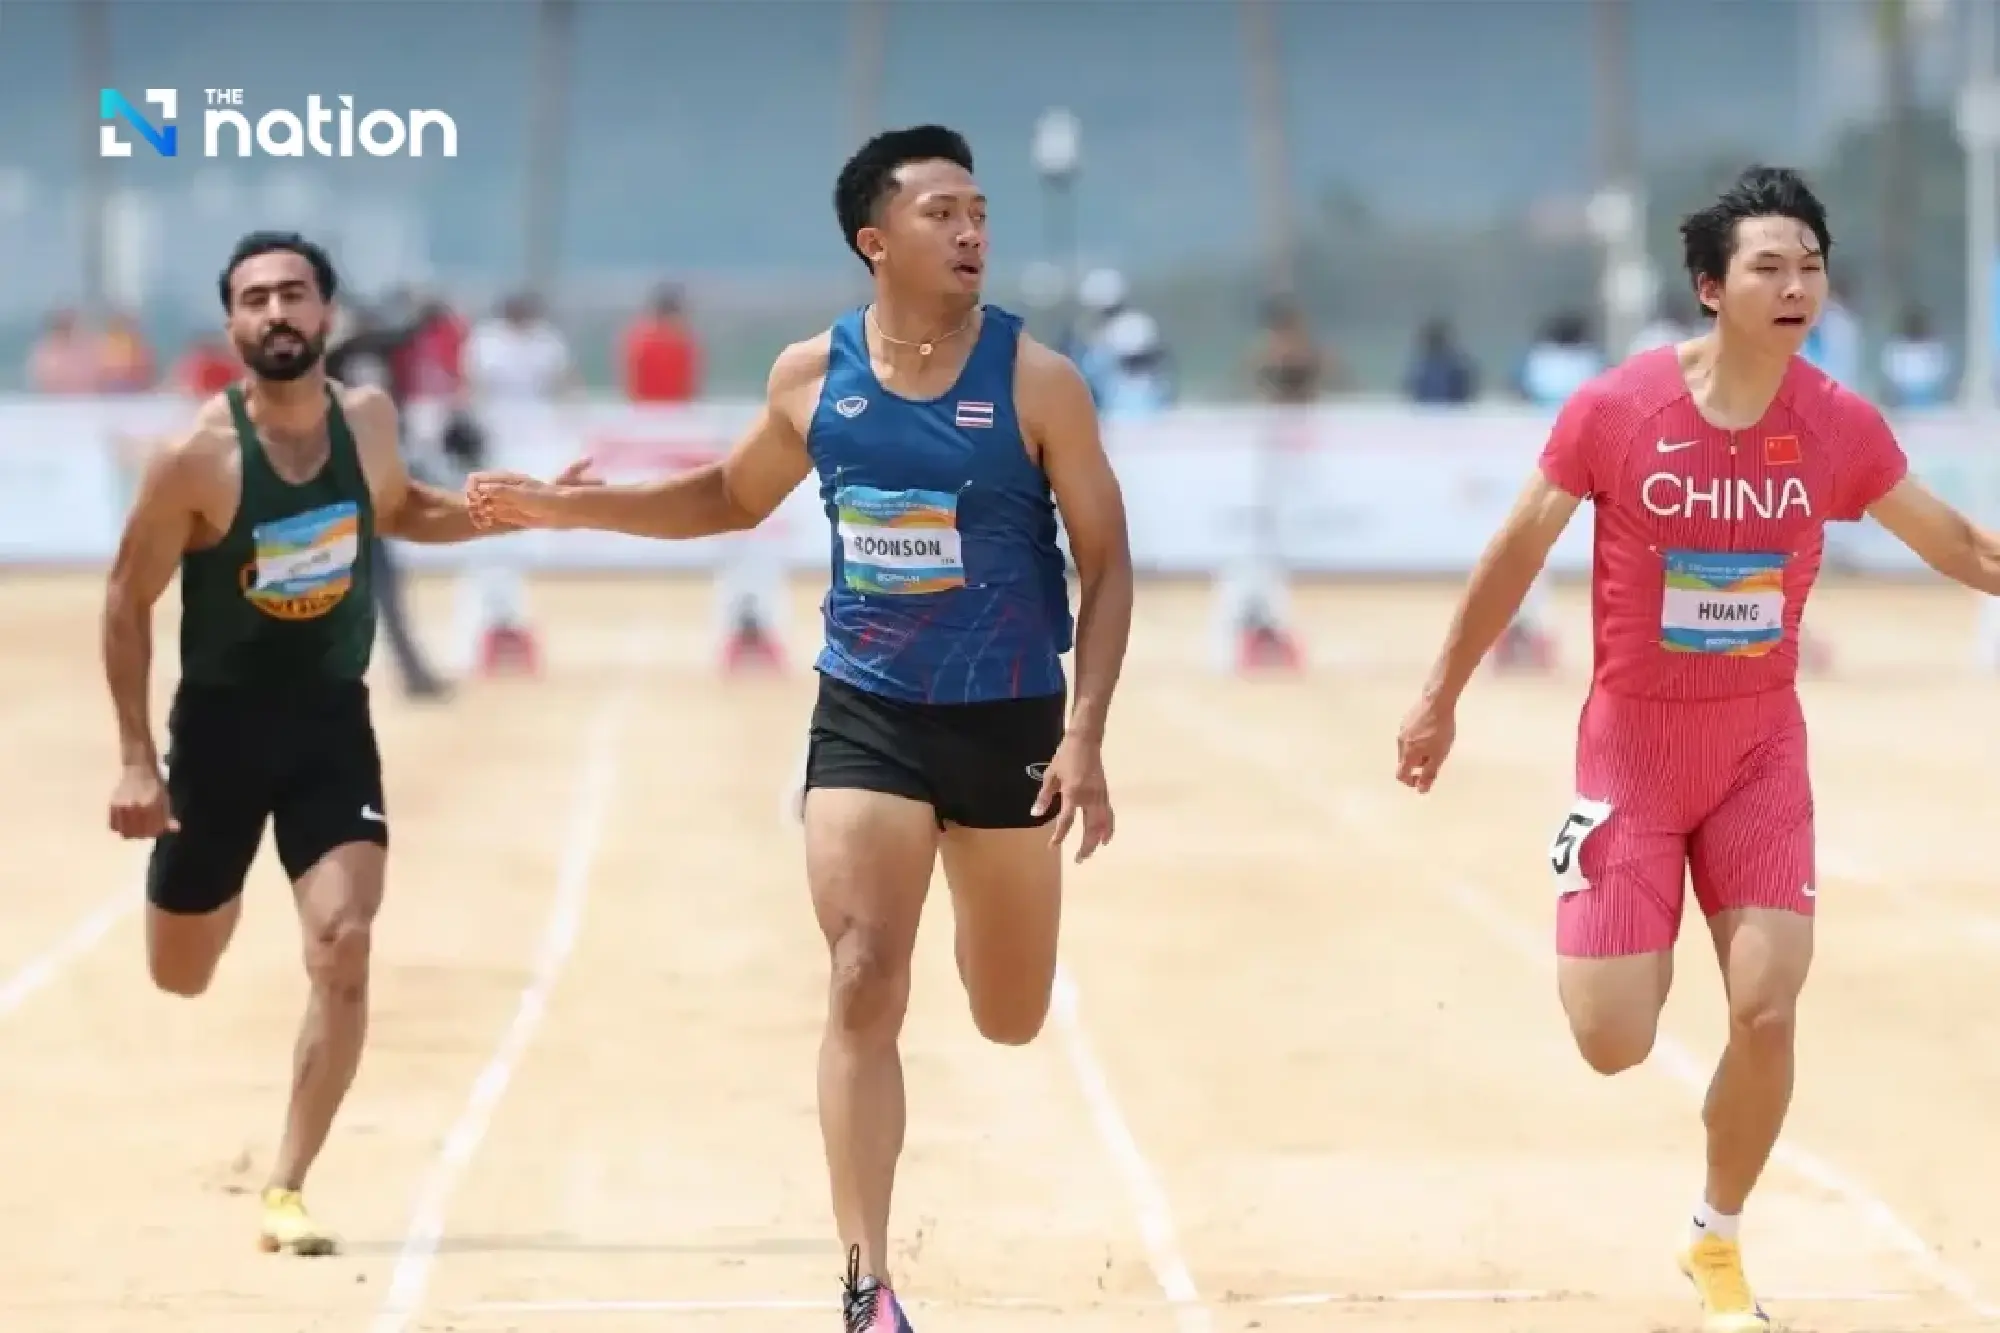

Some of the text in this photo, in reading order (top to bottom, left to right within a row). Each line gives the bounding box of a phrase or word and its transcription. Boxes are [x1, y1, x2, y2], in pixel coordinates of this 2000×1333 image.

[1642, 472, 1811, 519] CHINA
[1698, 602, 1760, 622] HUANG
[1552, 813, 1594, 874] 5
